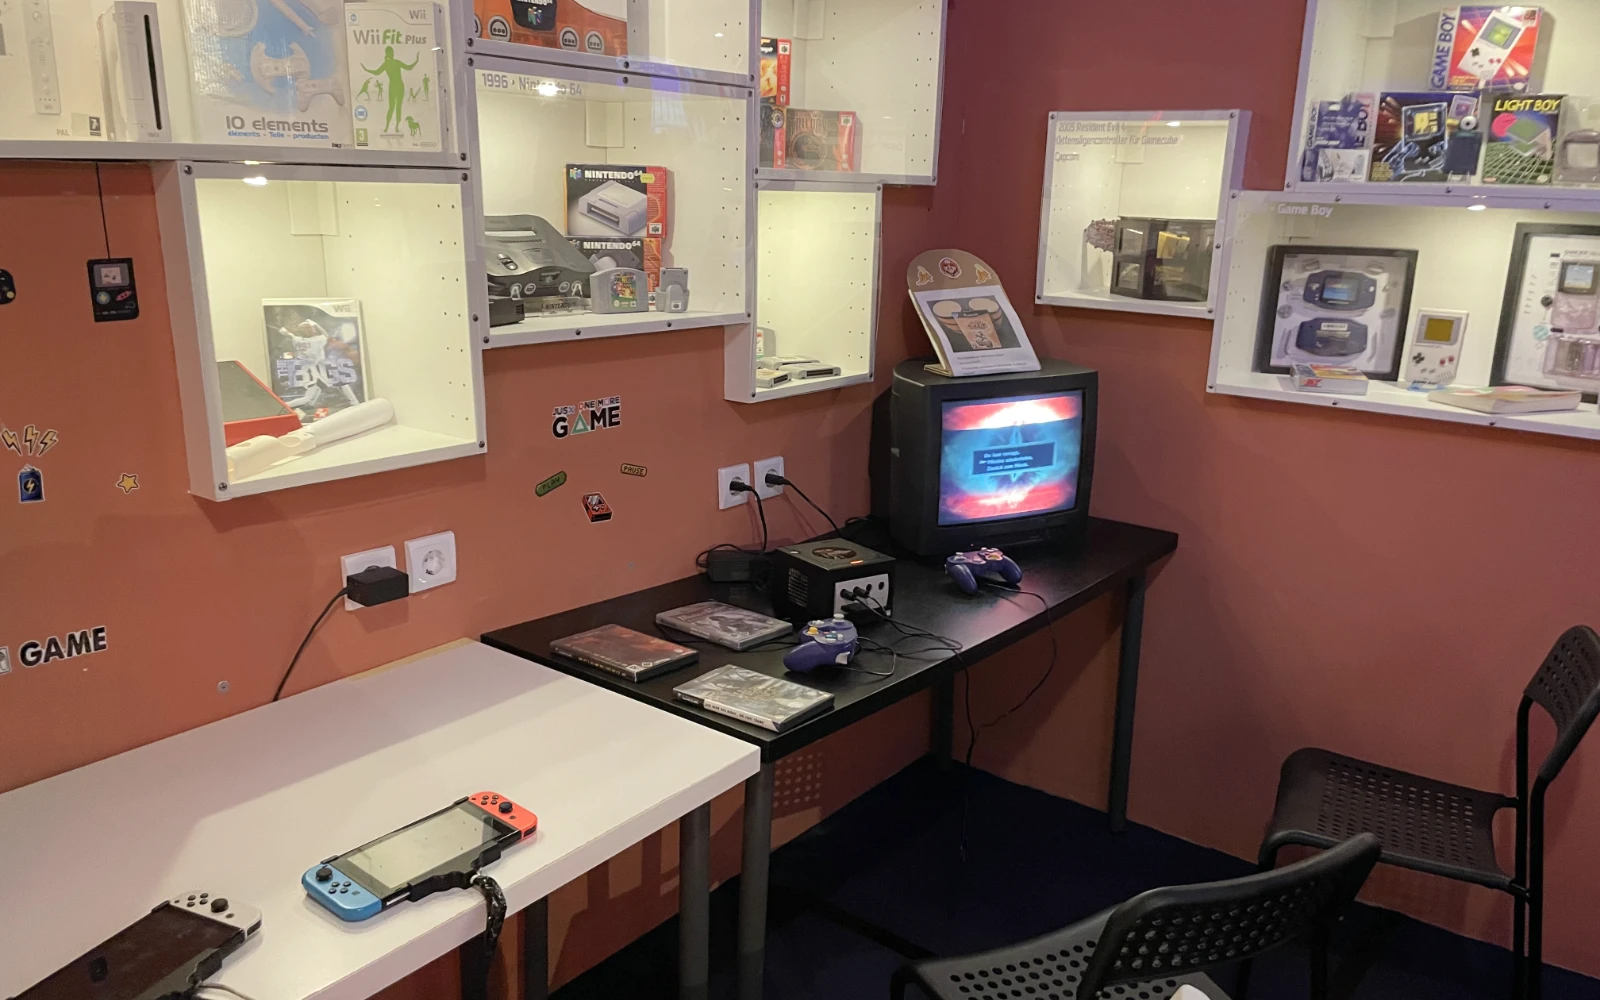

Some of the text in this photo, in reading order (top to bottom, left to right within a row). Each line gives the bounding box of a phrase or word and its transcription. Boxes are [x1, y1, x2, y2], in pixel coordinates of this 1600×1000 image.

[409, 10, 426, 20] Wii
[353, 29, 428, 45] Wii Fit Plus
[1431, 13, 1456, 88] GAME BOY
[482, 73, 582, 96] 1996 Nintdo 64
[1494, 99, 1560, 112] LIGHT BOY
[56, 128, 70, 137] PAL
[251, 117, 329, 133] elements
[1076, 121, 1105, 132] Resident
[1278, 203, 1334, 218] Game Boy
[332, 304, 351, 313] Wii
[579, 400, 596, 410] ONE
[598, 396, 620, 408] MORE
[552, 405, 621, 438] GAME
[623, 466, 645, 476] PAUSE
[541, 476, 562, 491] PLAY
[20, 626, 107, 667] GAME
